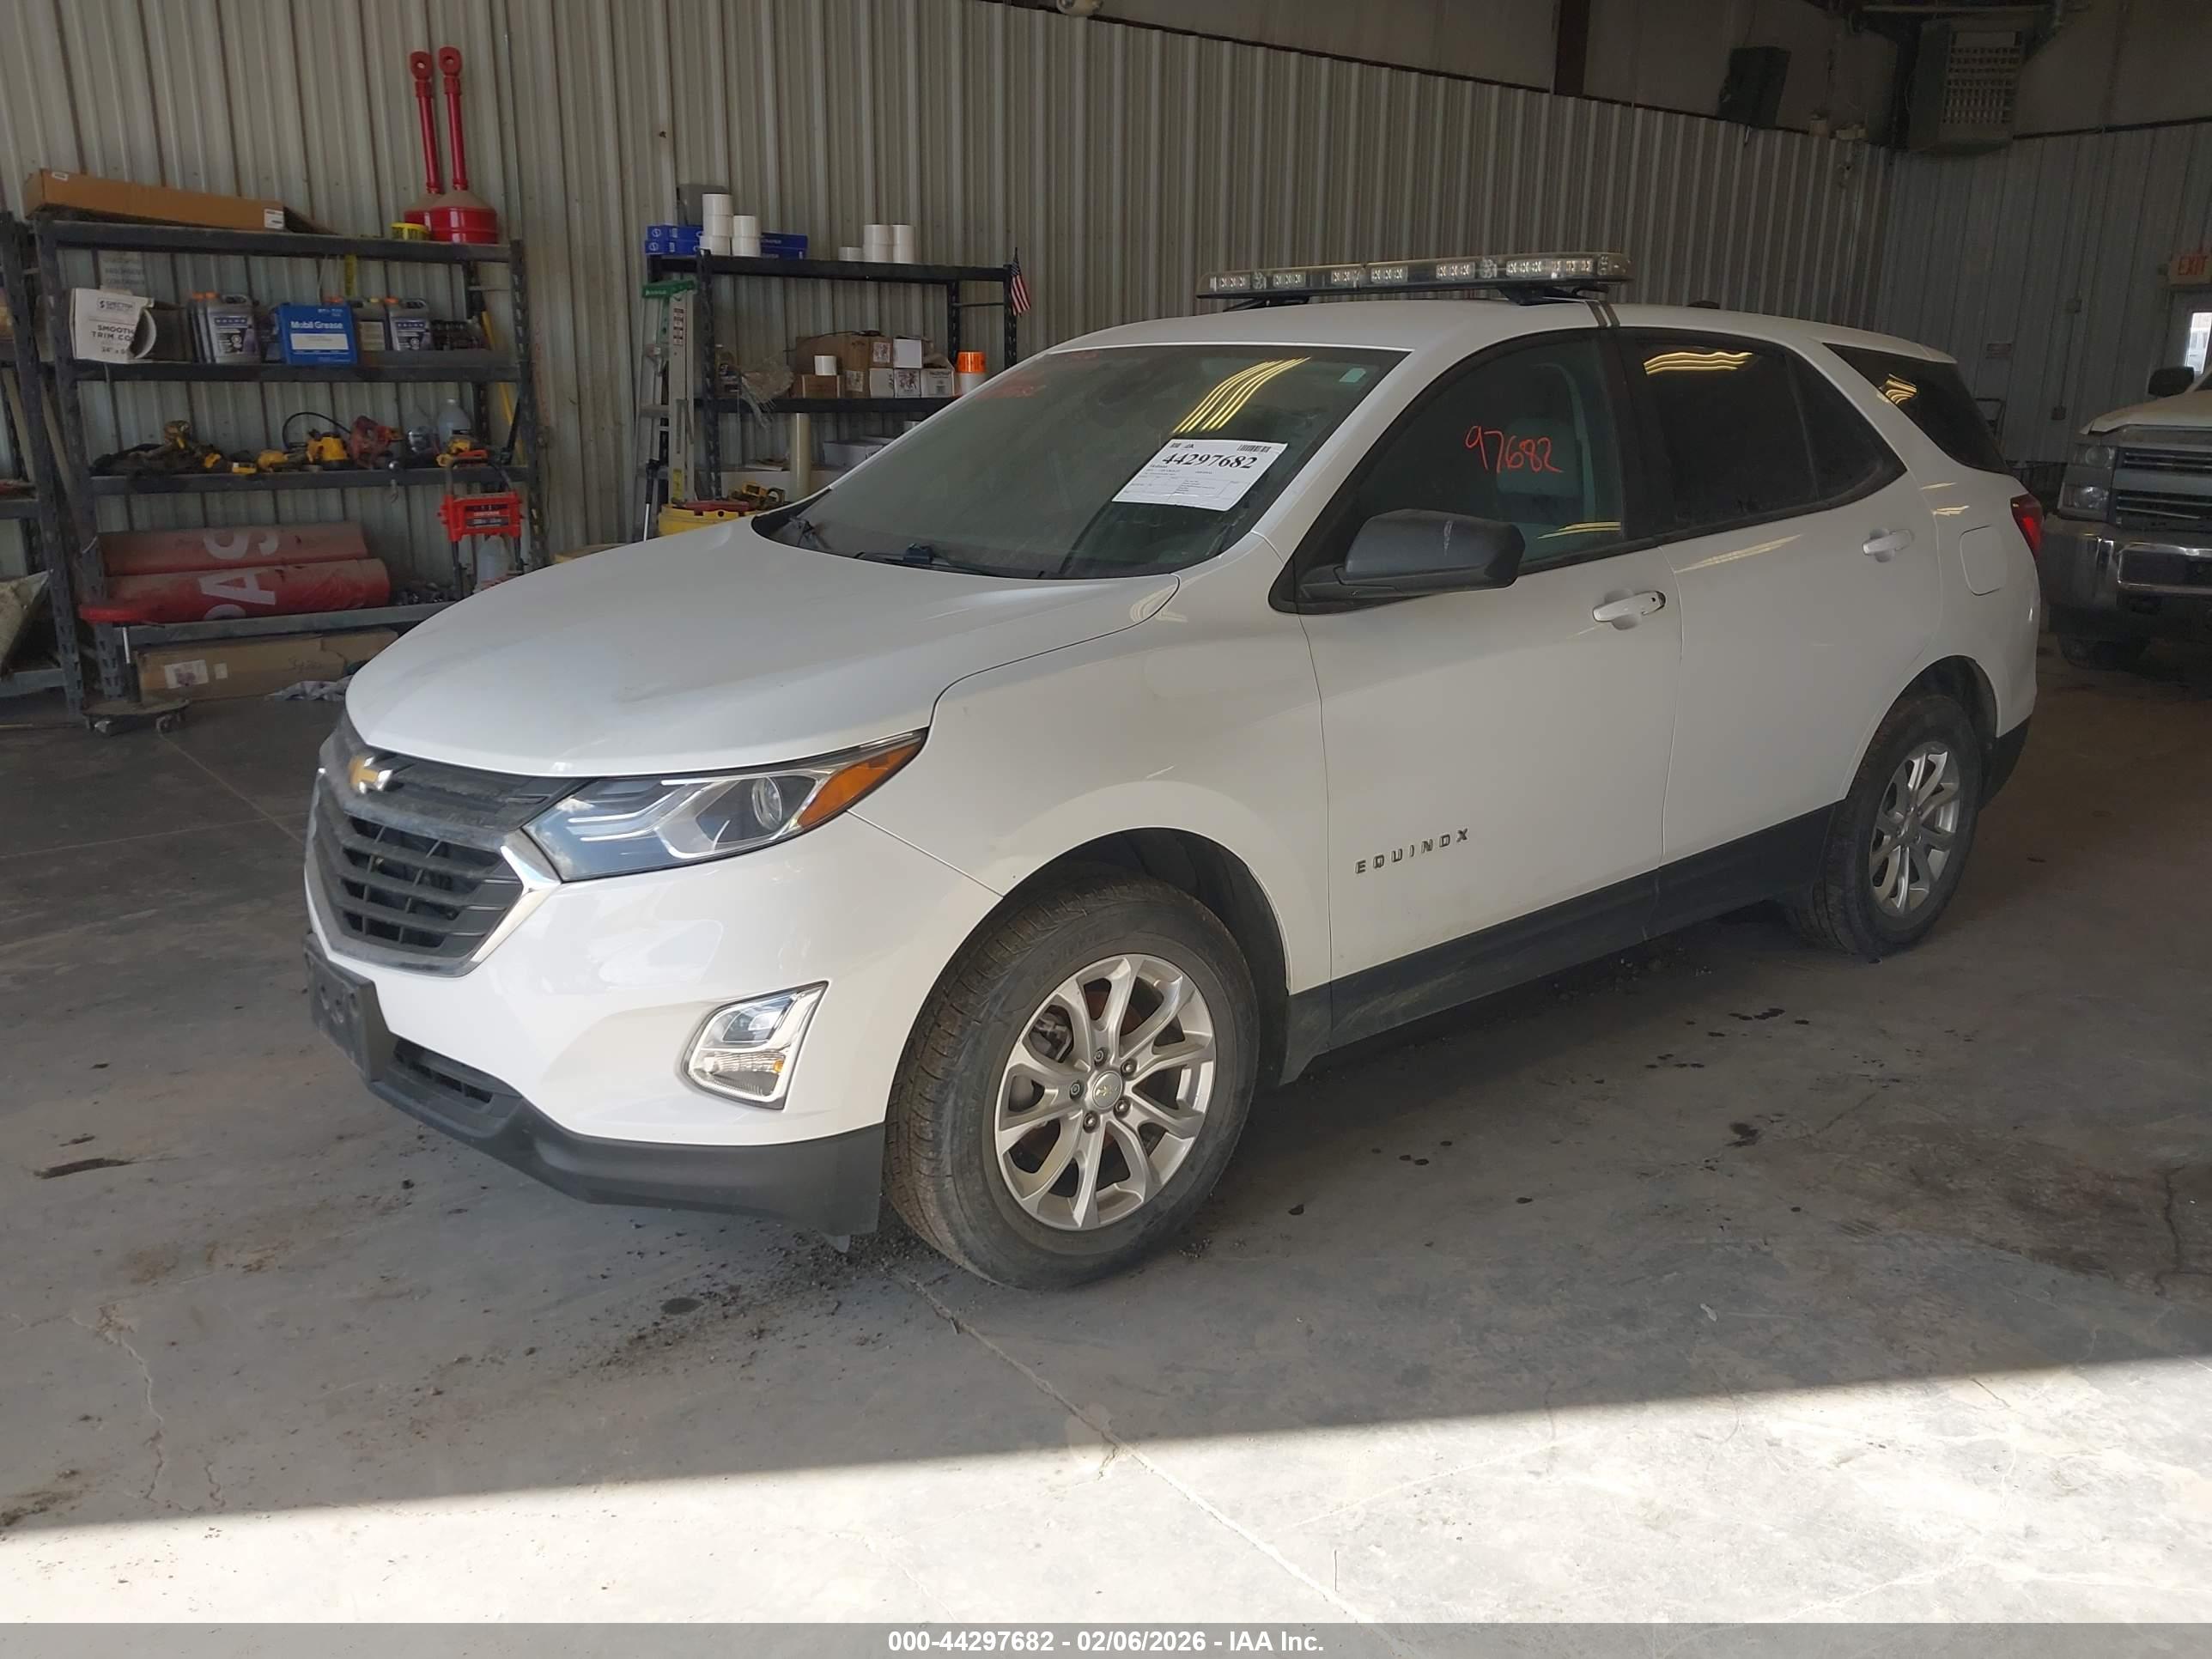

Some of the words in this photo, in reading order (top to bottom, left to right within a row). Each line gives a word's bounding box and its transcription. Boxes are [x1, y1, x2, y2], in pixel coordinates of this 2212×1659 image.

[2177, 257, 2208, 276] EXIT
[91, 331, 114, 340] TRIM
[1465, 425, 1565, 474] 97682
[1162, 453, 1258, 470] 44297682
[1355, 828, 1468, 874] EQUINOX
